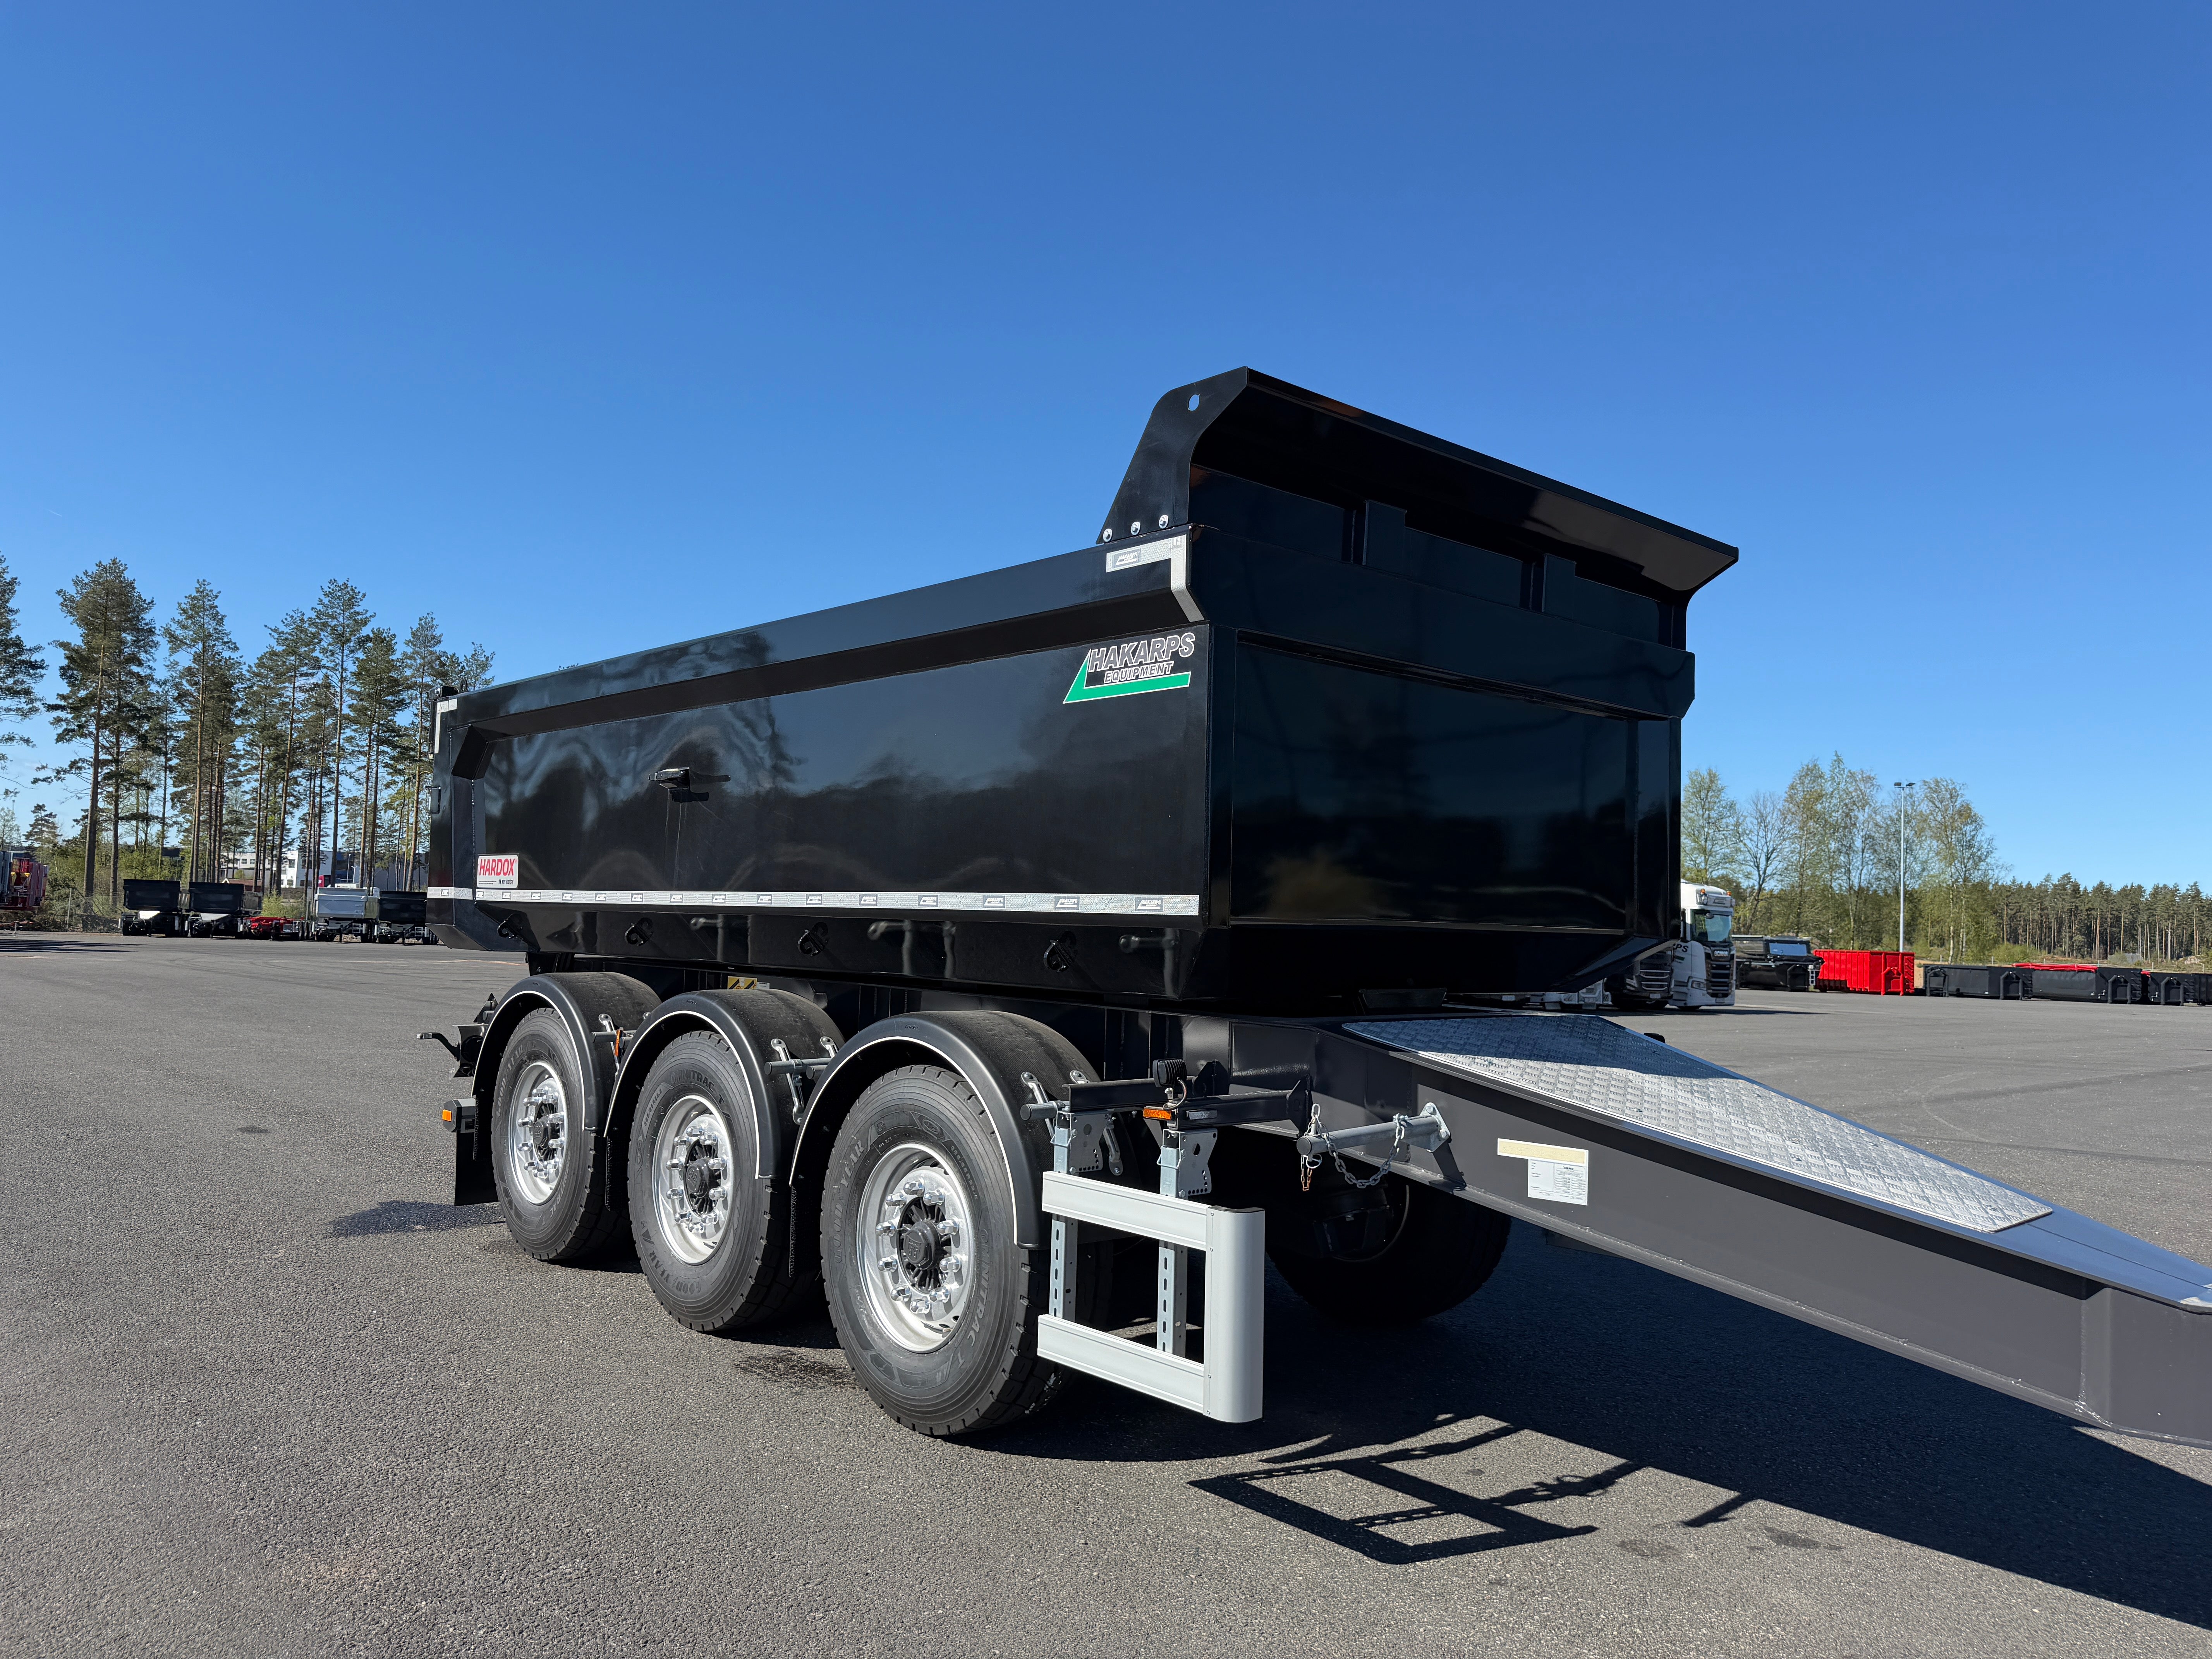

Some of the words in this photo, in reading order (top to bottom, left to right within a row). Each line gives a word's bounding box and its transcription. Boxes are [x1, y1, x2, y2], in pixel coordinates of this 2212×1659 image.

[1088, 632, 1195, 672] HAKARPS
[1104, 661, 1174, 684] EQUIPMENT
[479, 858, 516, 876] HARDOX
[671, 1069, 714, 1092] OMNITRAC
[719, 1094, 724, 1104] T
[833, 1139, 865, 1264] GOODYEAR
[649, 1250, 702, 1295] GOODYEAR
[967, 1228, 990, 1347] OMNITRAC
[957, 1352, 966, 1369] T
